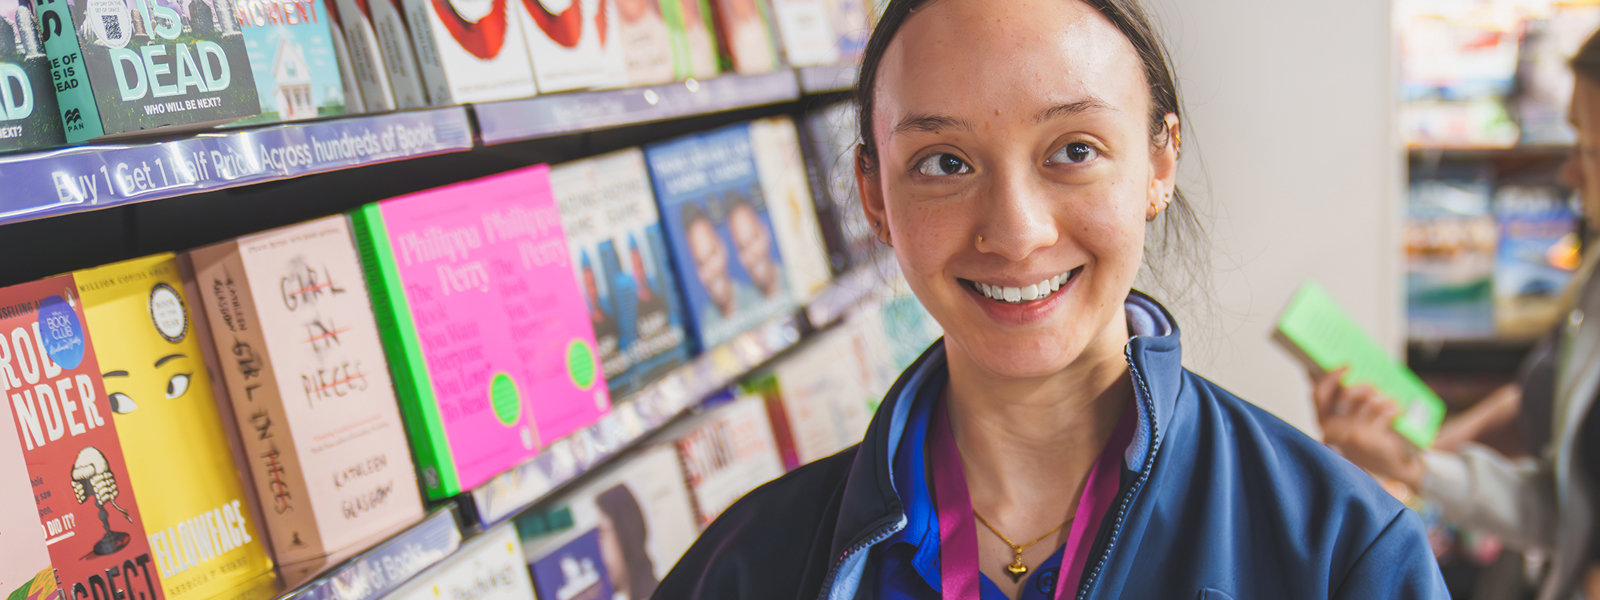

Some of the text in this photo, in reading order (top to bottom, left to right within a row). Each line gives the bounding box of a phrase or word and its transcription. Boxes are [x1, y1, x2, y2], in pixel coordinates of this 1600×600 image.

[136, 0, 182, 40] IS
[62, 53, 77, 65] OF
[63, 66, 75, 78] IS
[109, 41, 231, 101] DEAD
[144, 97, 222, 115] WHO WILL BE NEXT?
[67, 122, 84, 132] PAN
[52, 171, 97, 204] Buy
[100, 165, 114, 195] 1
[116, 161, 155, 193] Get
[155, 157, 168, 186] 1
[211, 149, 256, 179] Pric
[260, 144, 313, 171] Across
[310, 130, 381, 163] hundreds
[381, 127, 396, 151] of
[395, 123, 437, 149] Books
[398, 224, 482, 267] Philippa
[281, 264, 346, 311] GIRL
[436, 260, 489, 296] Perry
[46, 315, 72, 330] BOOK
[52, 326, 74, 340] CLUB
[305, 316, 340, 353] IN
[301, 360, 368, 409] PIECES
[11, 374, 104, 451] NDER
[46, 518, 63, 536] DID
[61, 512, 76, 530] IT?
[147, 499, 252, 579] ELLOWFACE
